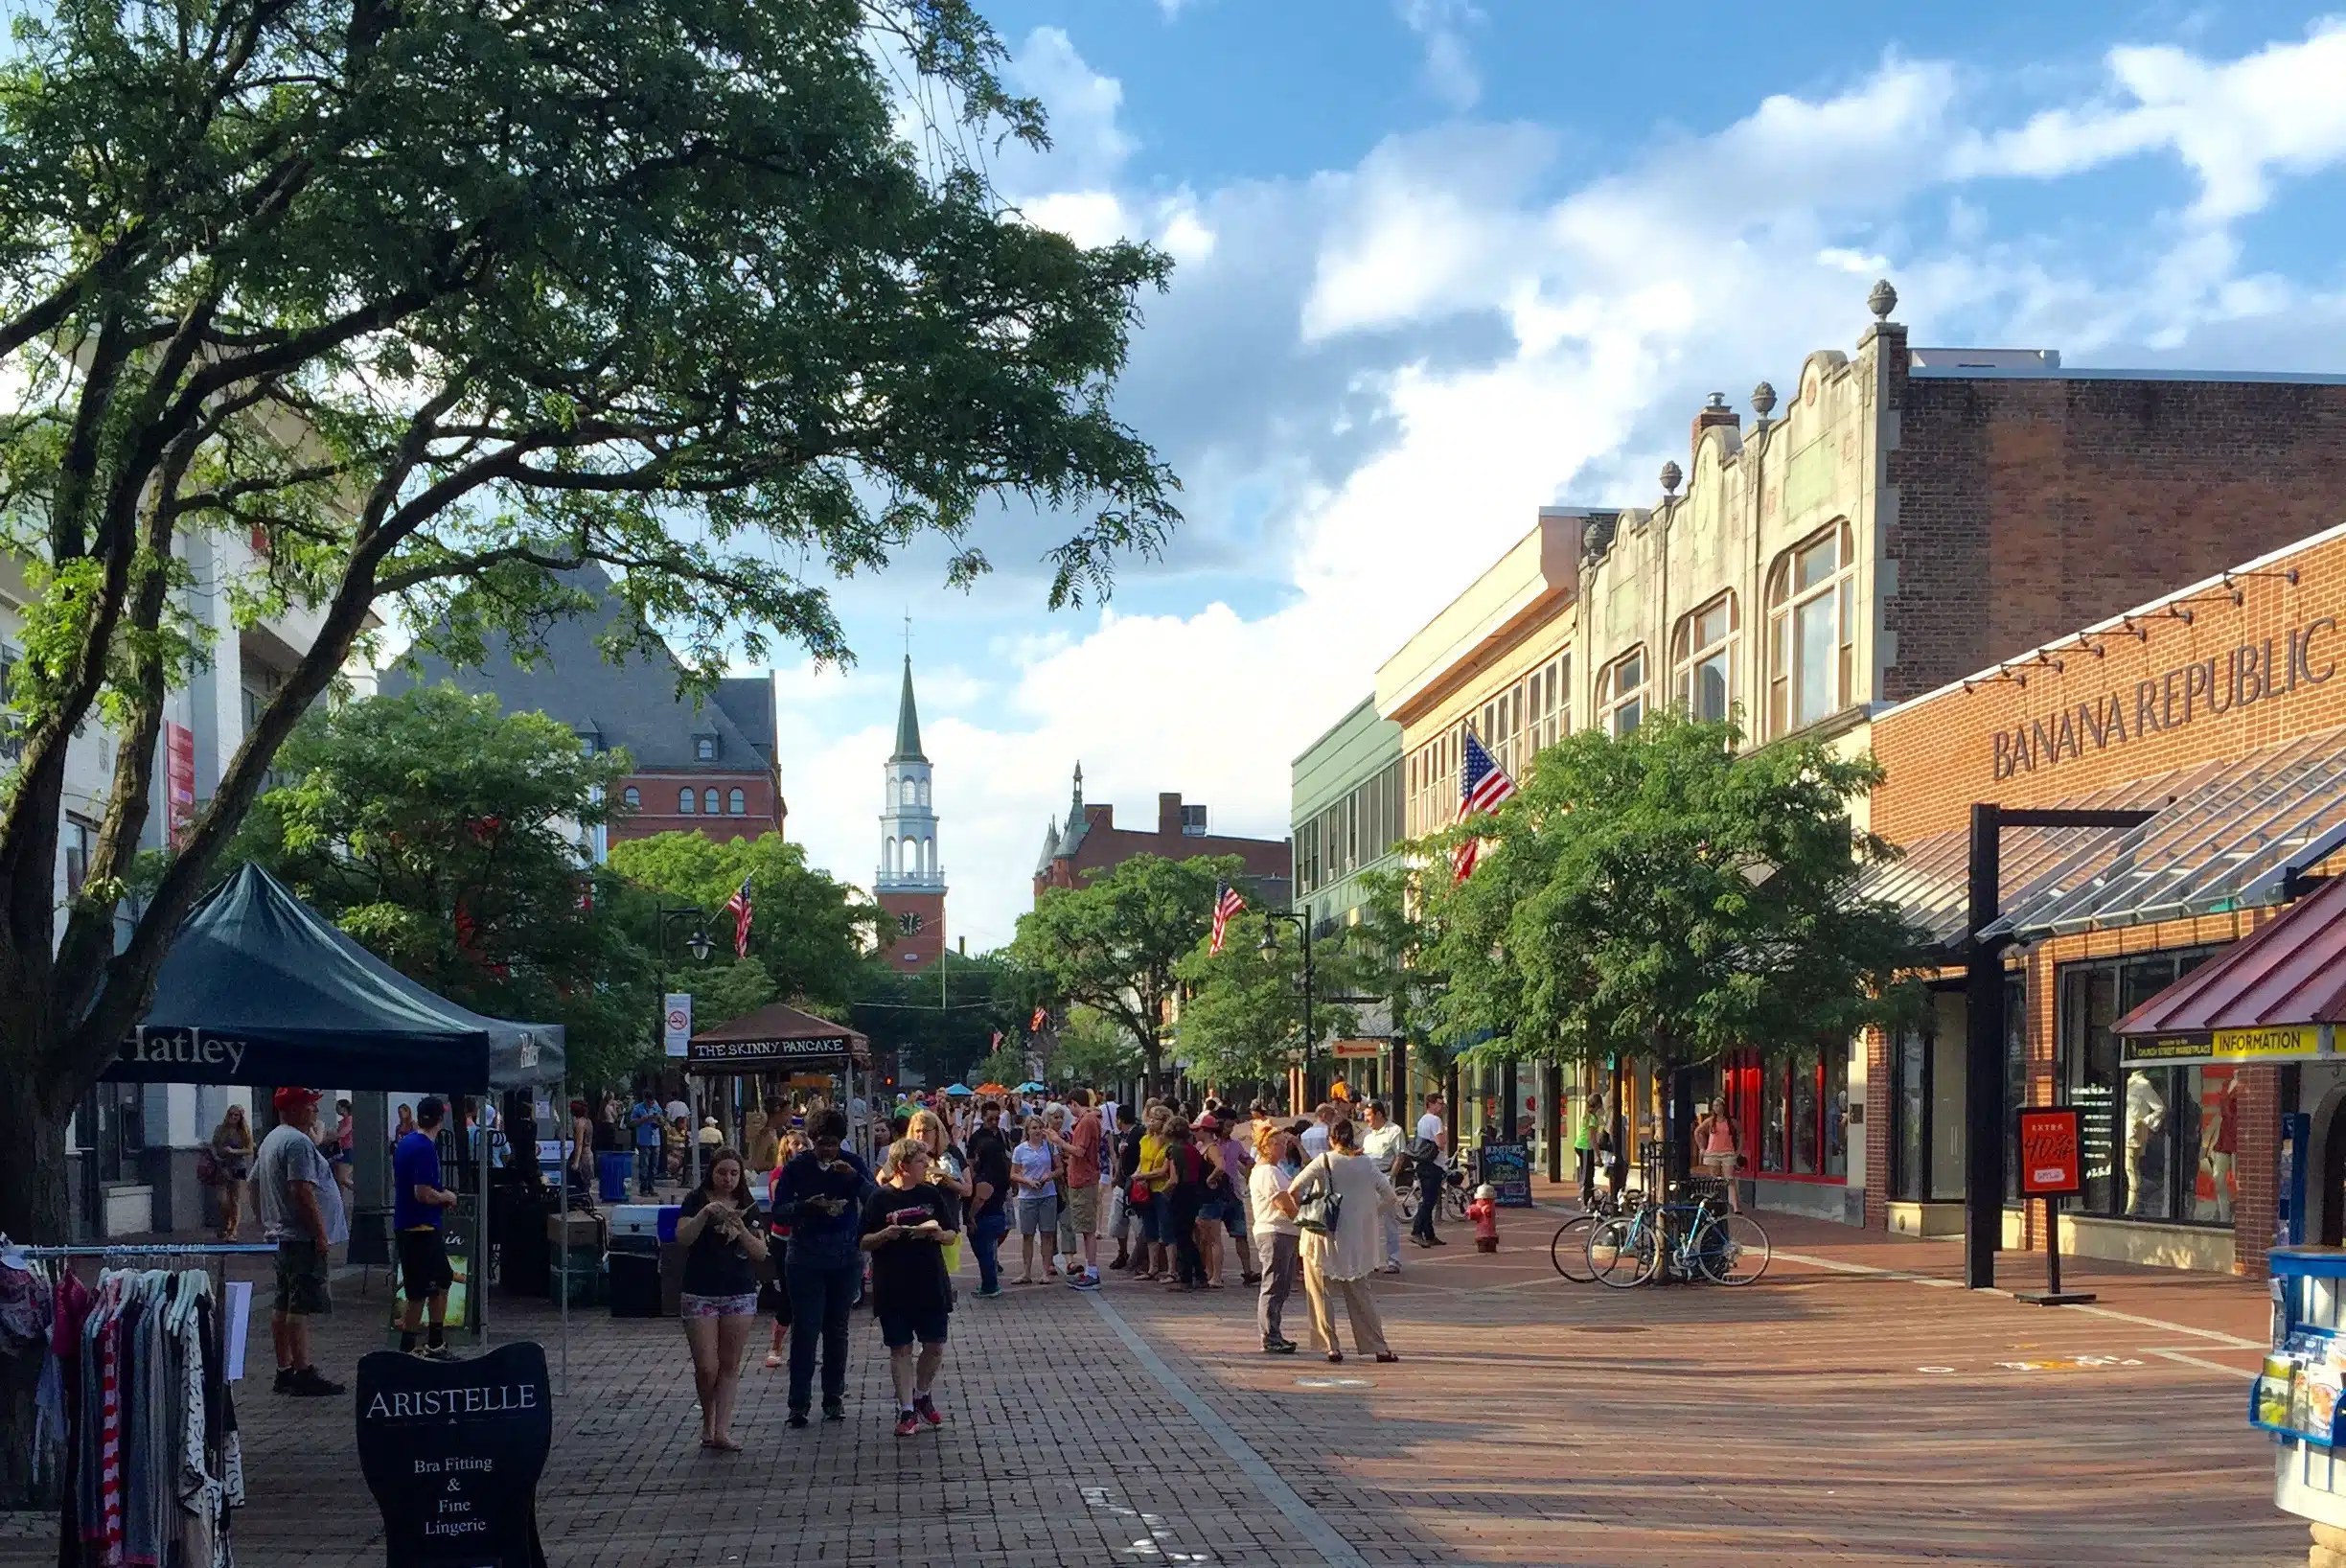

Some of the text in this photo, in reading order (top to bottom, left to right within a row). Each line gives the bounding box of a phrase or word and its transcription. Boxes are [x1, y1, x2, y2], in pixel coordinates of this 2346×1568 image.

[1993, 616, 2336, 781] BANANA REPUBLIC
[111, 1025, 247, 1074] Hatley
[695, 1044, 726, 1057] THE
[728, 1041, 780, 1055] SKINNY
[782, 1038, 844, 1053] PANCAKE
[2219, 1031, 2301, 1051] INFORMATION
[2032, 1123, 2064, 1132] EXTRA
[366, 1384, 538, 1418] ARISTELLE
[414, 1456, 494, 1474] Bra Fitting
[447, 1478, 462, 1492] &
[438, 1499, 472, 1513] Fine
[425, 1518, 487, 1536] Lingerie
